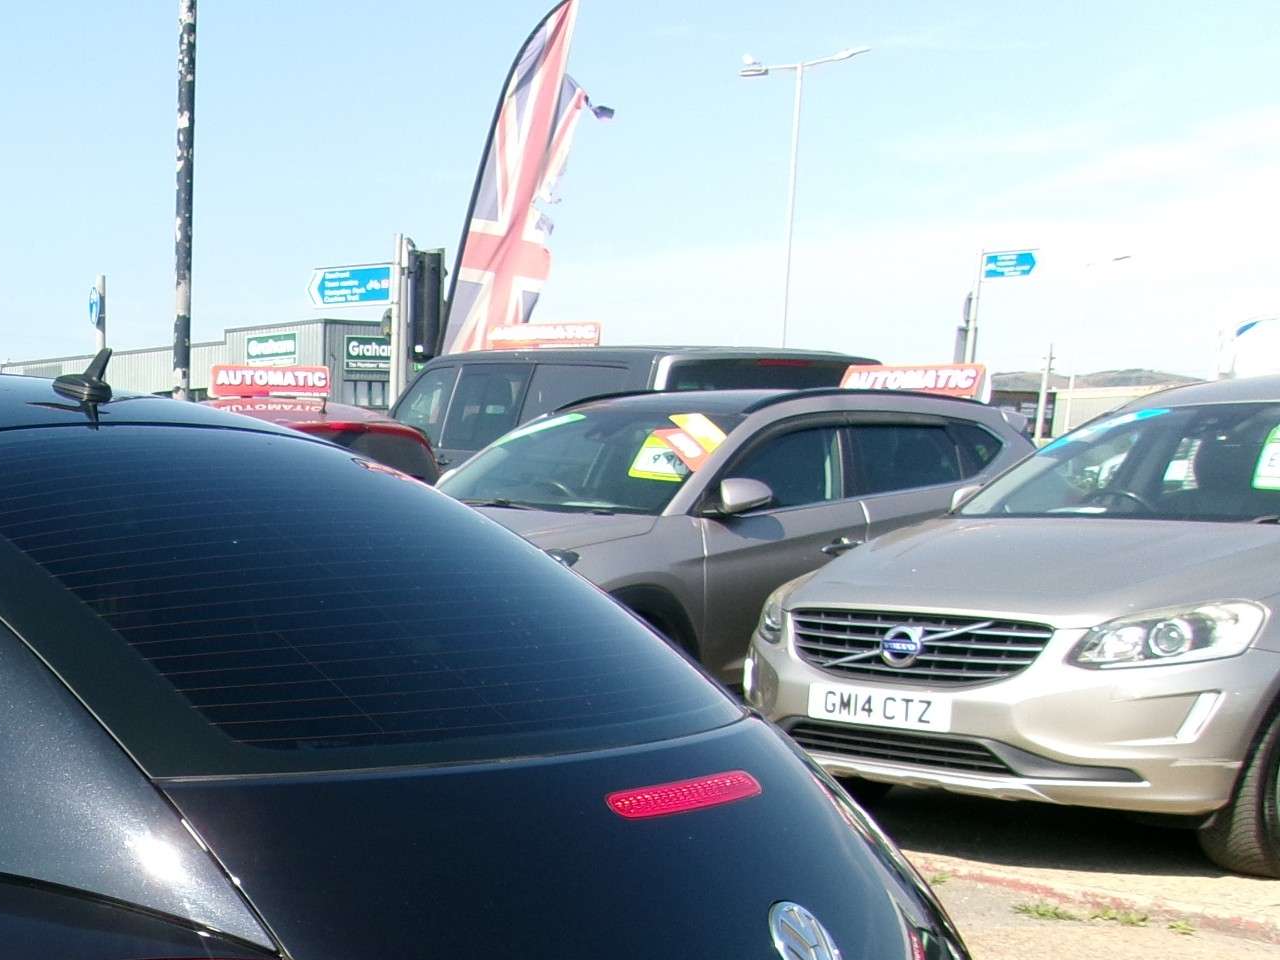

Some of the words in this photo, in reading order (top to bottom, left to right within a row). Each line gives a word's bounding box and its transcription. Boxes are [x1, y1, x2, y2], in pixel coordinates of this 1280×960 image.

[216, 370, 327, 388] AUTOMATIC
[844, 369, 977, 390] AUTOMATIC
[824, 690, 873, 718] GM14
[882, 697, 932, 725] CTZ
